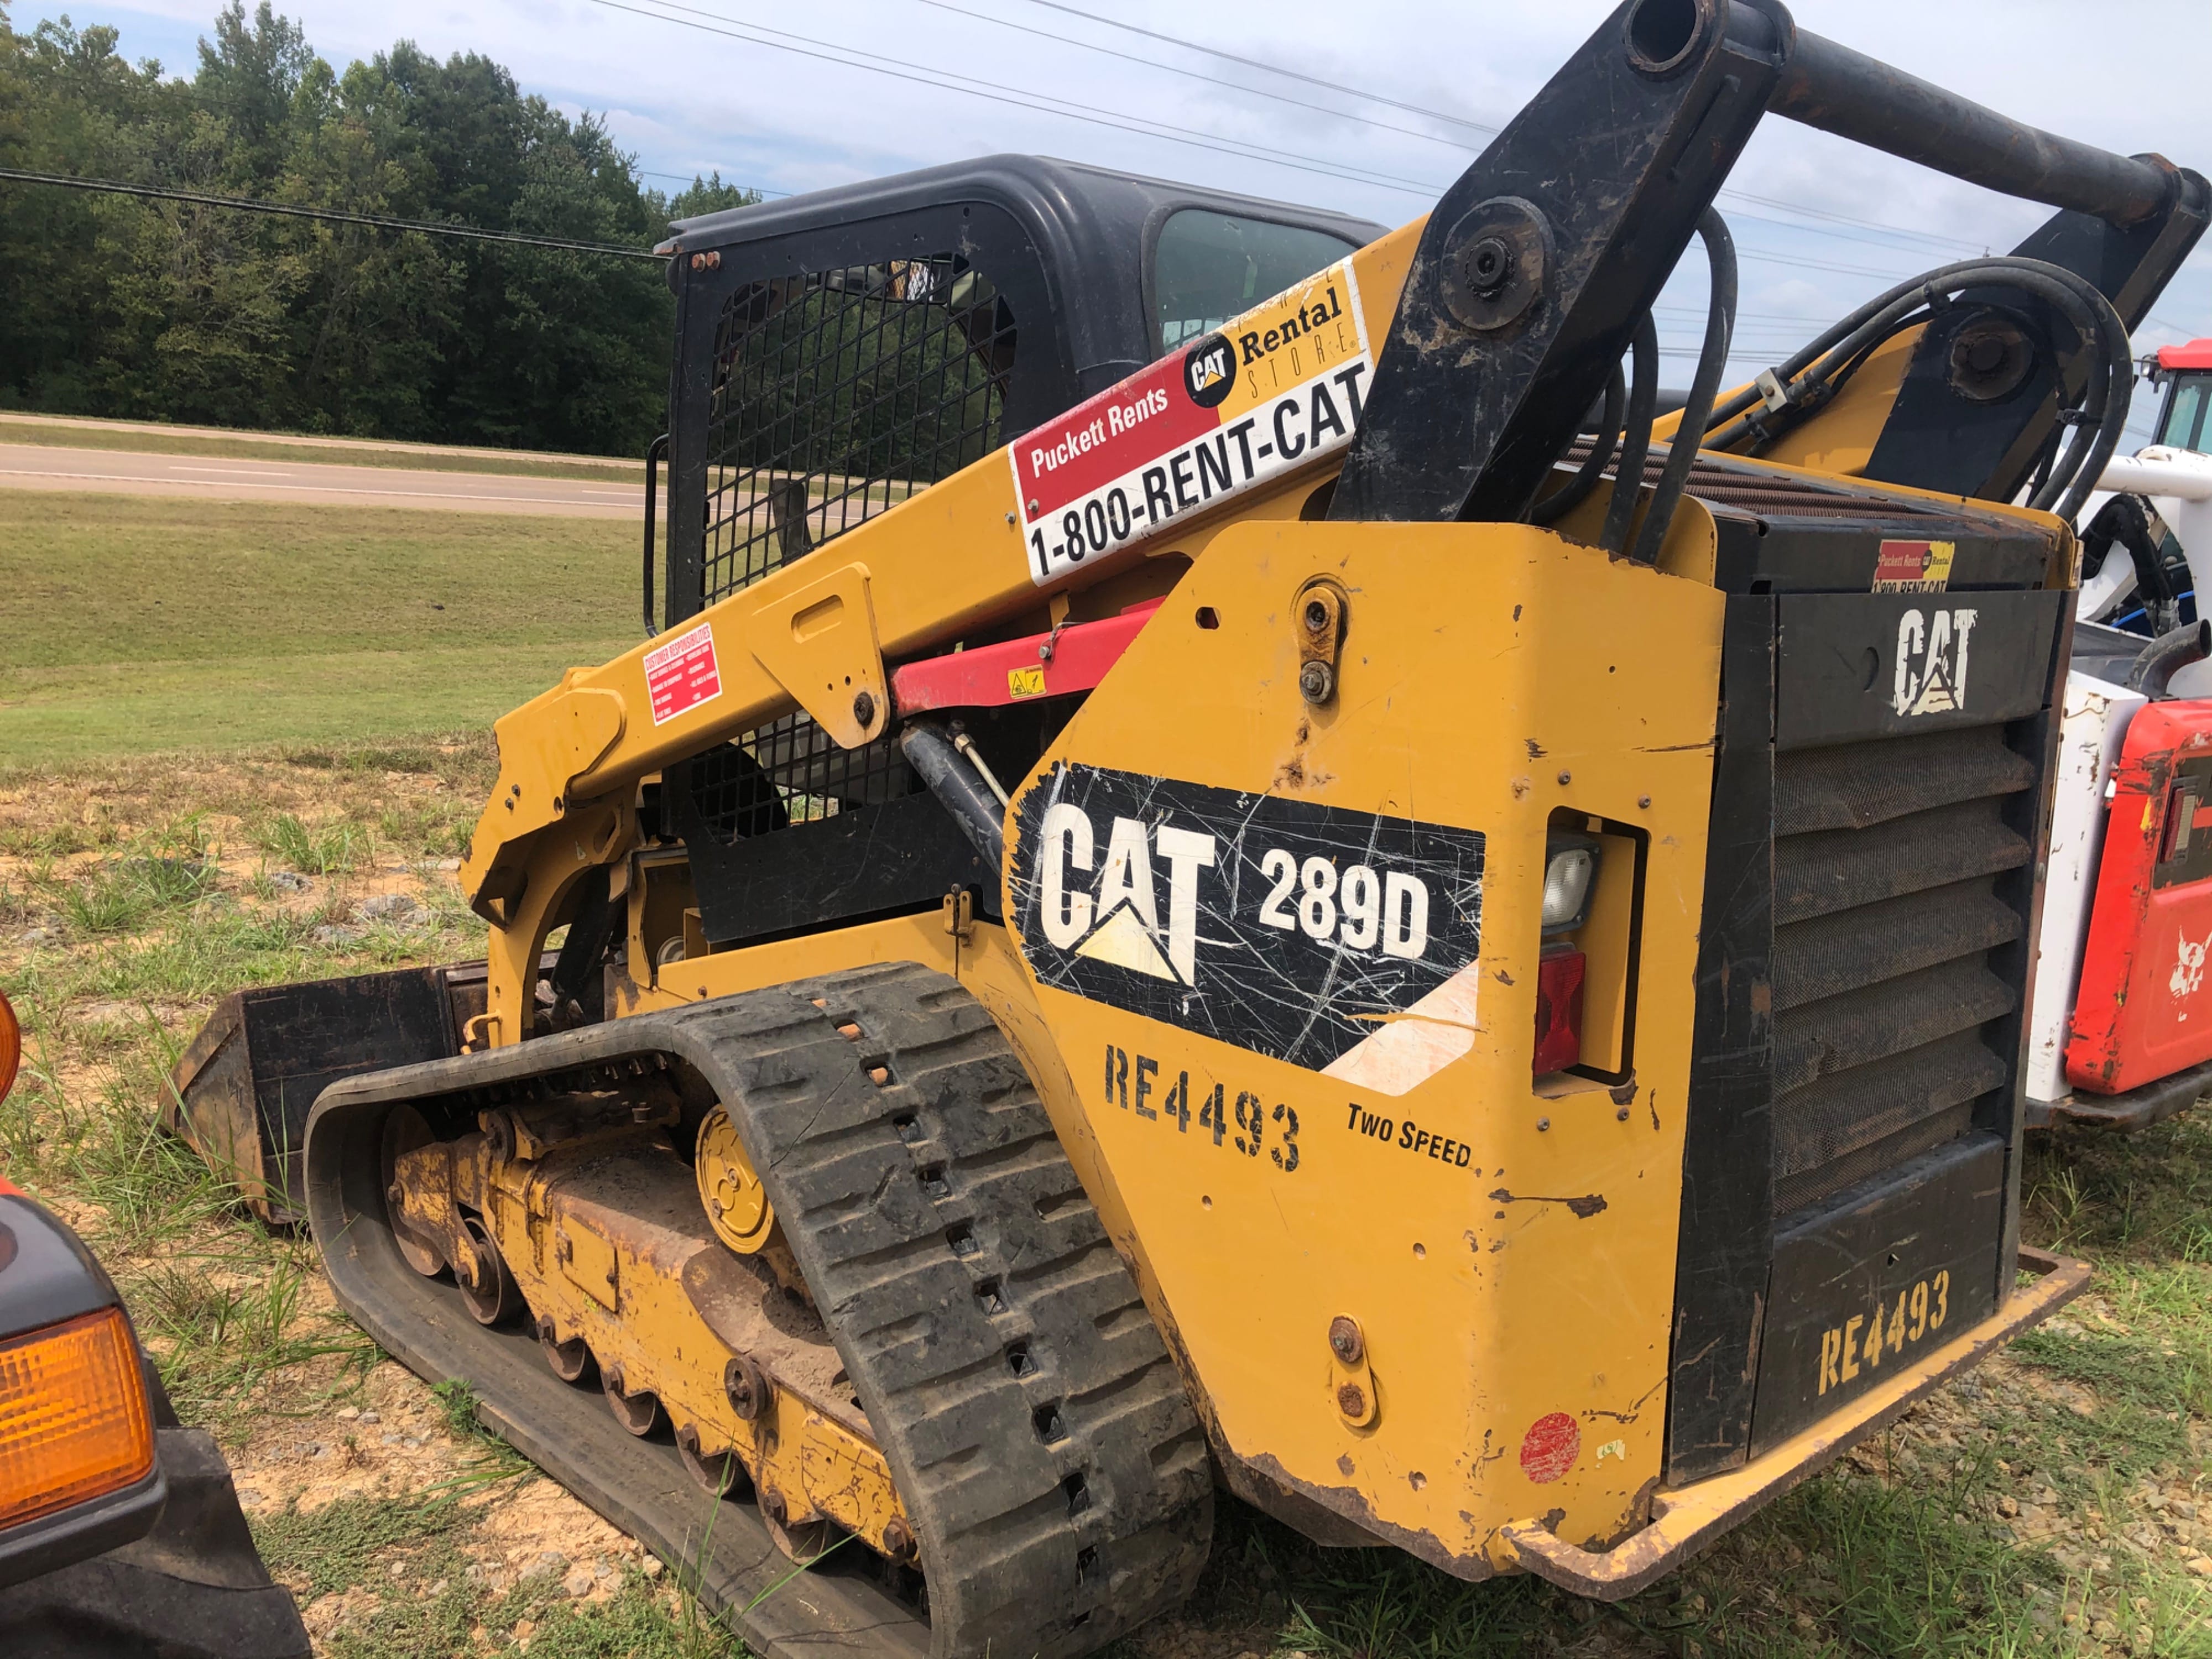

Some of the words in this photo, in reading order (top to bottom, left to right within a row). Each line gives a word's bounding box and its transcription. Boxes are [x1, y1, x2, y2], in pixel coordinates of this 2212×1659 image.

[1191, 347, 1226, 392] CAT
[1239, 286, 1342, 366] Rental
[1031, 418, 1106, 477] Puckett
[1107, 387, 1168, 437] Rents
[1031, 361, 1365, 576] 1-800-RENT-CAT
[1881, 554, 1902, 566] Puckett
[1932, 556, 1950, 565] Rental
[645, 648, 670, 671] CUSTOMER
[669, 625, 711, 659] RESPONSIBILITIES
[1894, 608, 1978, 717] CAT
[1040, 802, 1215, 987] CAT
[1259, 849, 1428, 959] 289D
[1105, 1044, 1299, 1172] RE4493
[1818, 1270, 1949, 1396] RE4493
